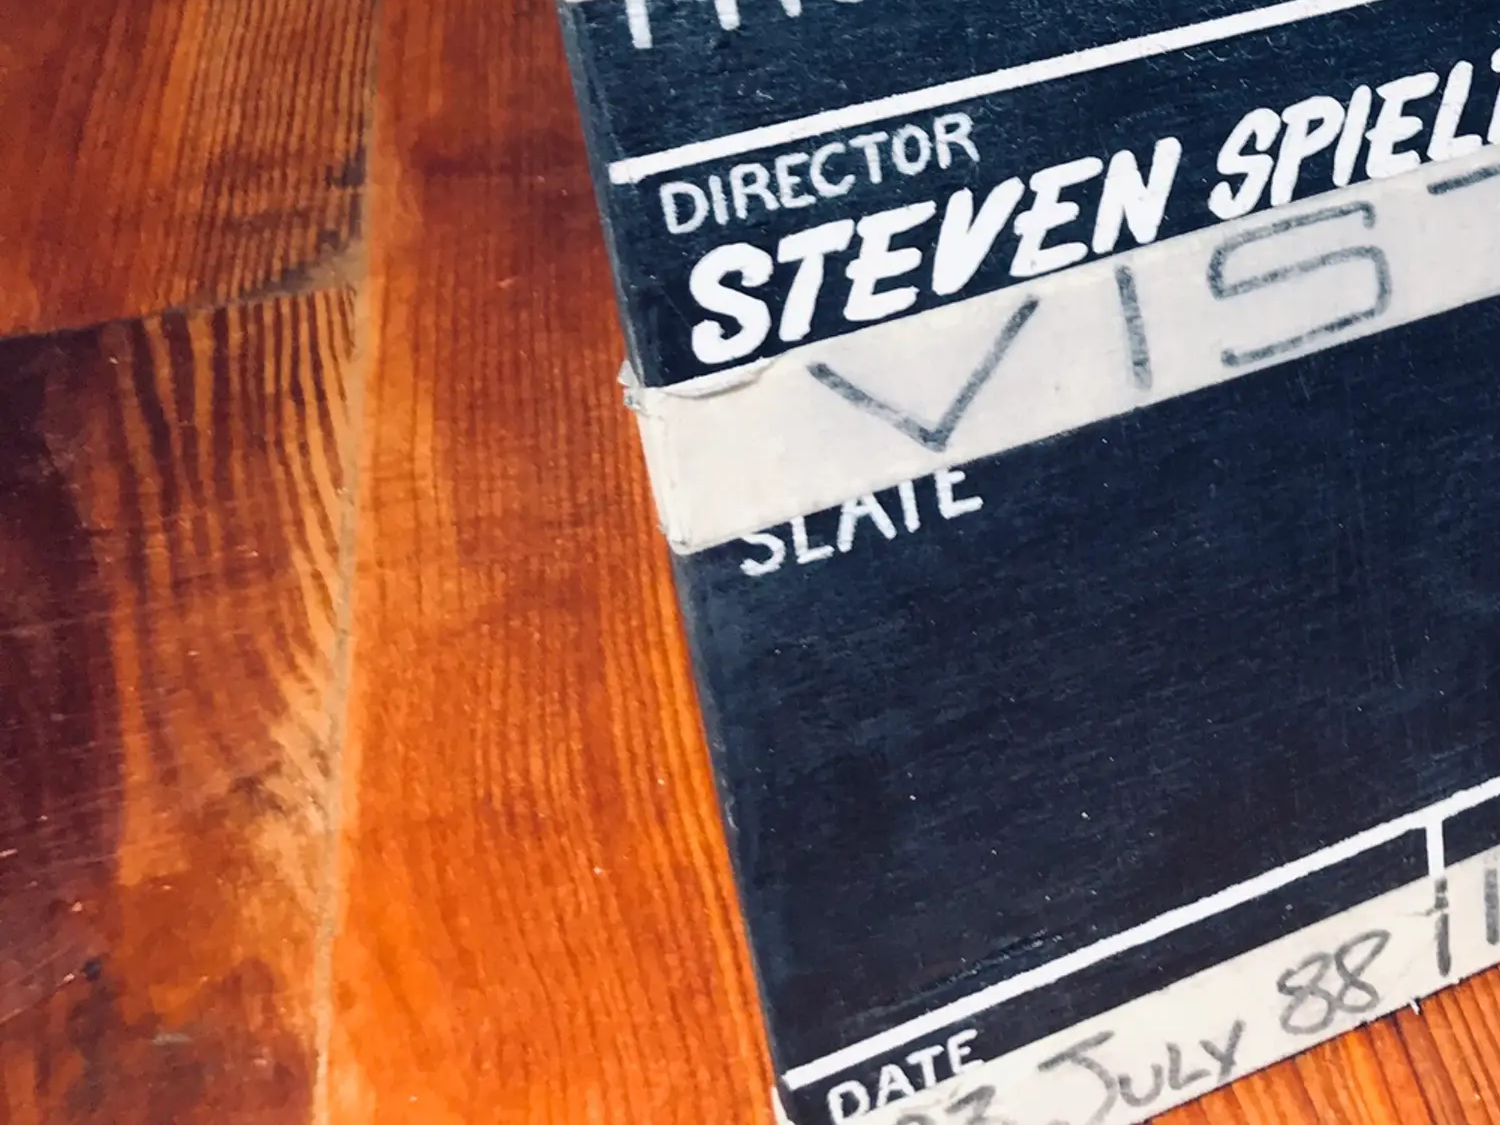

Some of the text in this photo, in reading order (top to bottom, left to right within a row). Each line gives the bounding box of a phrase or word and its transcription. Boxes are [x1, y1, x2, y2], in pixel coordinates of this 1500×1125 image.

[658, 112, 981, 236] DIRECTOR
[688, 136, 1183, 365] STEVEN
[740, 468, 984, 576] SLATE
[1276, 929, 1392, 1035] 88
[826, 1028, 986, 1125] DATE
